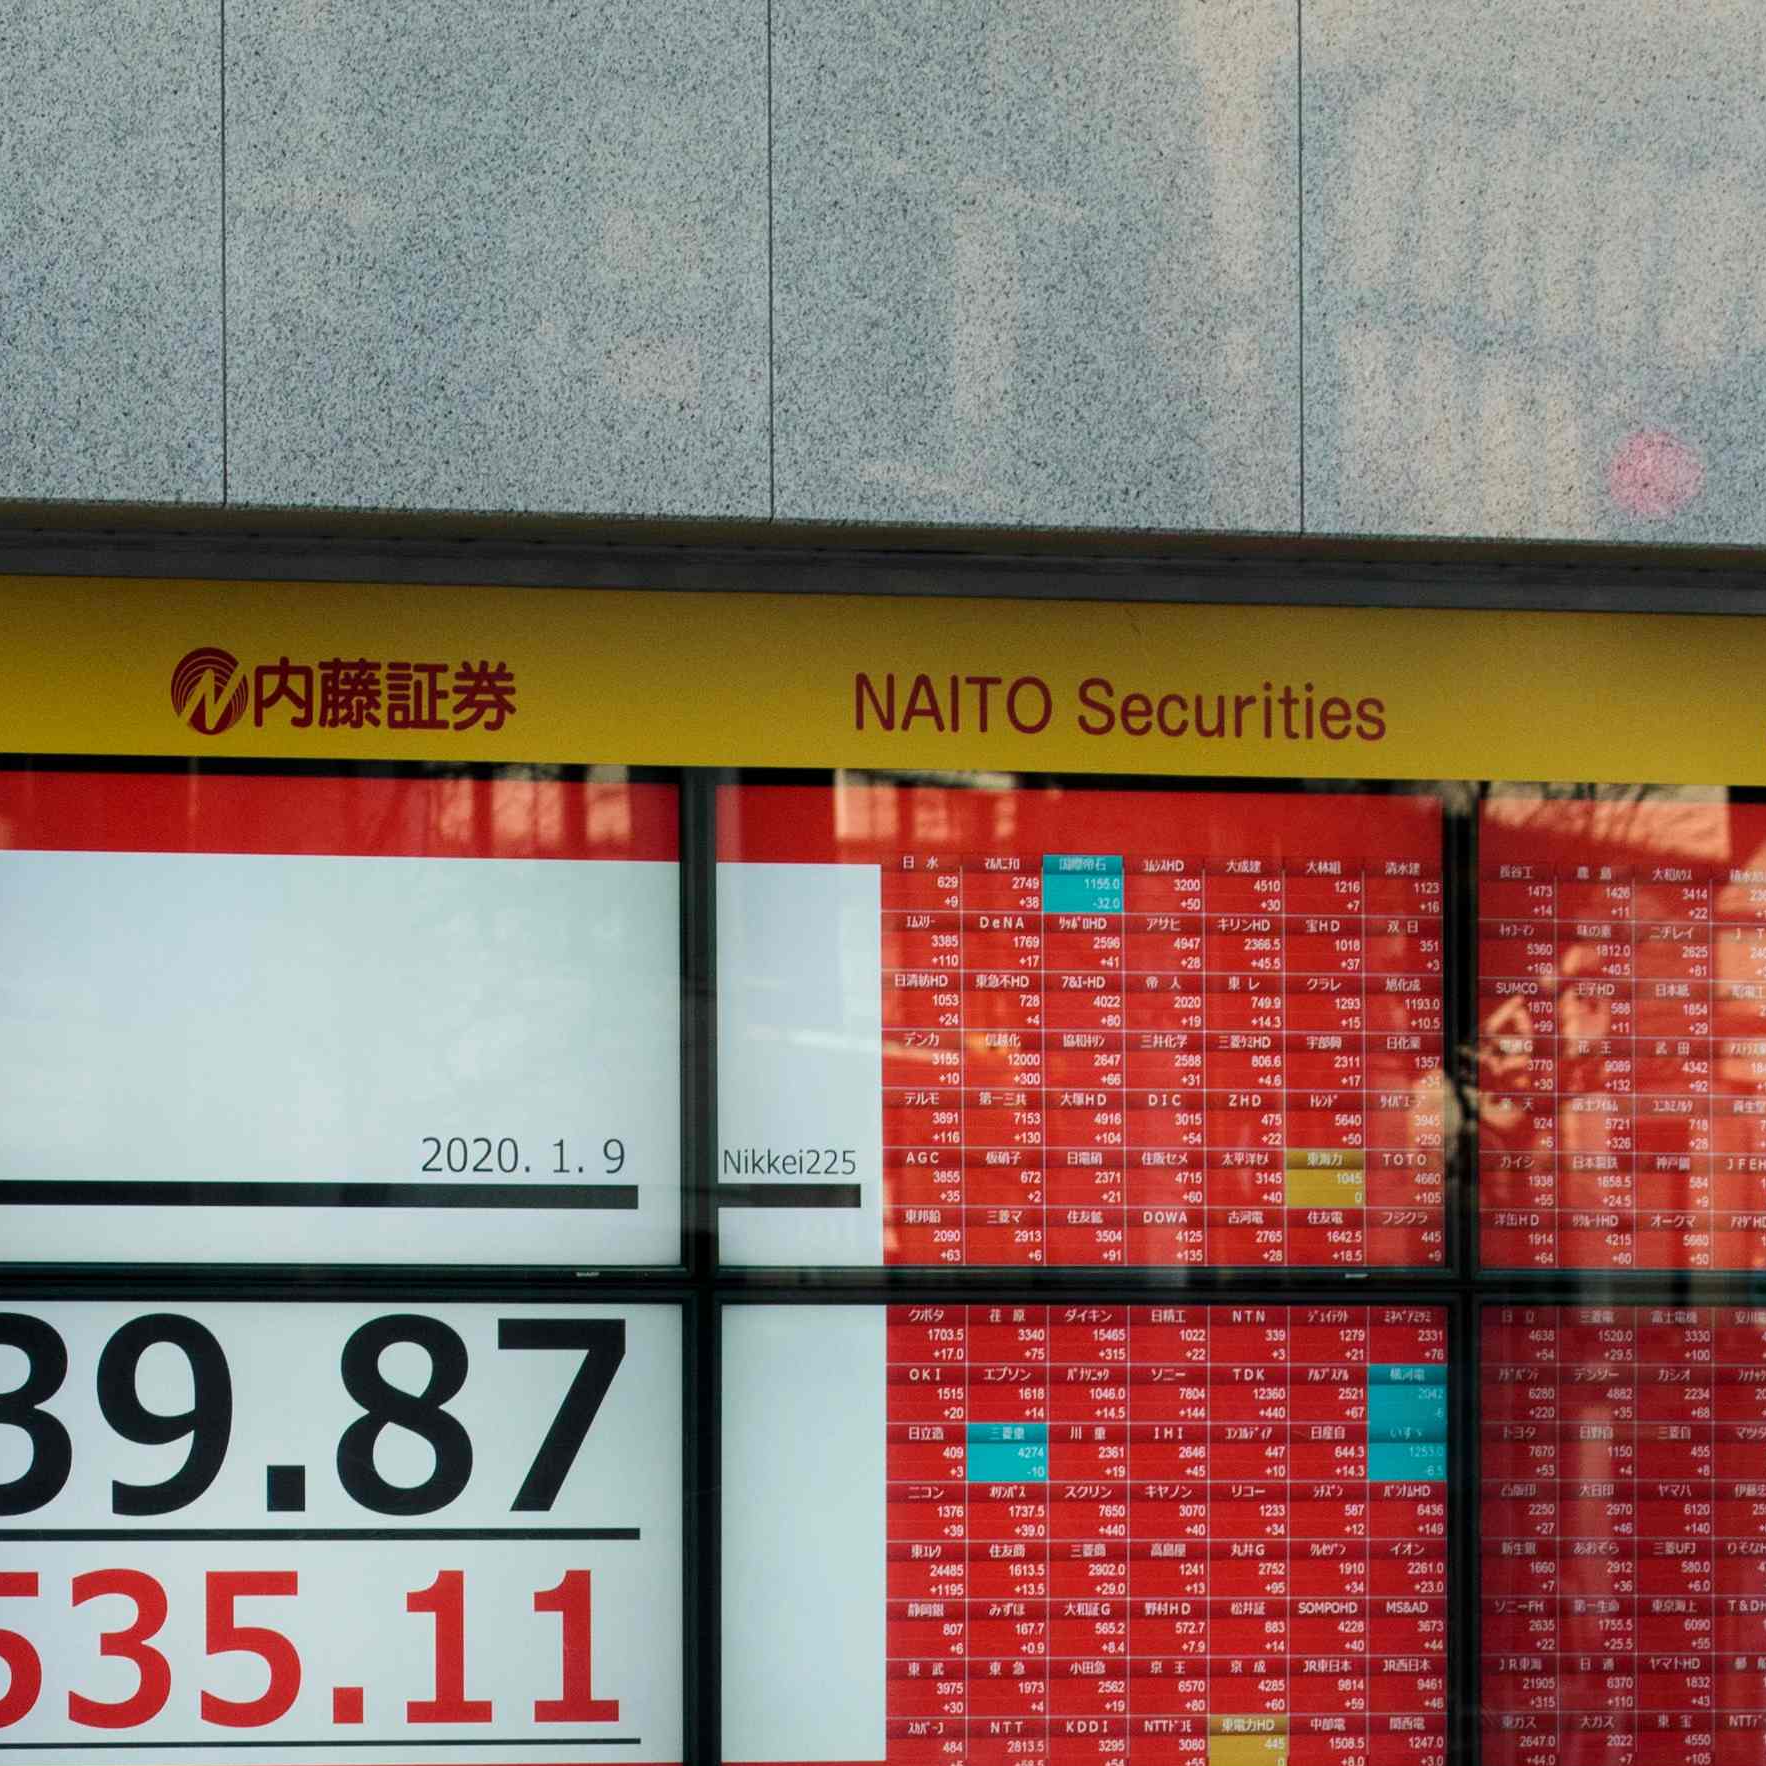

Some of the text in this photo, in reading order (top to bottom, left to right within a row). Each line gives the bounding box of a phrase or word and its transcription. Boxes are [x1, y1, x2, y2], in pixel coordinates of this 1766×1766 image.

[252, 657, 517, 734] 内藤証券
[854, 672, 1386, 742] NAITO Securities
[936, 875, 962, 889] 629
[1012, 876, 1040, 889] 2749
[1173, 878, 1201, 892] 3200
[1253, 879, 1284, 893] 4510
[1334, 880, 1361, 894] 1216
[1528, 885, 1554, 898] 1473
[944, 895, 962, 909] +9
[1180, 897, 1204, 911] +50
[1260, 898, 1284, 912] +30
[1346, 899, 1360, 911] +7
[1533, 905, 1553, 917] +14
[1146, 916, 1181, 931] アサヒ
[1013, 935, 1040, 949] 1769
[1018, 954, 1040, 967] +17
[1250, 957, 1282, 971] +45.5
[1306, 977, 1342, 992] クラレ
[1019, 994, 1040, 1008] 728
[1092, 995, 1121, 1009] 4022
[1334, 997, 1362, 1011] 1293
[1340, 1016, 1362, 1030] +15
[1012, 1072, 1041, 1085] +300
[905, 1091, 940, 1105] テルモ
[932, 1111, 959, 1125] 3891
[1013, 1111, 1042, 1125] 7153
[1174, 1112, 1202, 1126] 3015
[1260, 1113, 1283, 1127] 475
[1014, 1131, 1042, 1144] +130
[1182, 1131, 1202, 1145] +54
[1261, 1131, 1283, 1146] +22
[420, 1137, 532, 1176] 2020.
[602, 1137, 626, 1176] 9
[722, 1147, 858, 1177] Nikkei225
[1014, 1229, 1042, 1243] 2913
[1174, 1230, 1203, 1243] 4125
[1175, 1249, 1203, 1262] +135
[908, 1308, 944, 1322] クボタ
[1064, 1308, 1112, 1323] ダイキン
[928, 1327, 964, 1341] 1703.5
[1179, 1328, 1206, 1342] 1022
[1265, 1329, 1286, 1342] 339
[933, 1347, 964, 1361] +17.0
[1098, 1347, 1126, 1361] +315
[984, 1366, 1032, 1381] エプソン
[1151, 1367, 1186, 1381] ソニー
[937, 1387, 964, 1400] 1515
[1684, 1387, 1710, 1401] 2234
[943, 1406, 964, 1420] +20
[1024, 1407, 1045, 1419] +14
[1178, 1407, 1206, 1419] +144
[1258, 1406, 1286, 1419] +440
[1264, 1445, 1286, 1458] 447
[1184, 1465, 1206, 1478] +45
[908, 1486, 944, 1499] ニコン
[1064, 1485, 1112, 1499] スクリン
[1231, 1484, 1266, 1497] リコー
[1178, 1503, 1206, 1517] 3070
[1259, 1503, 1286, 1517] 1233
[1684, 1521, 1711, 1535] +140
[1390, 1542, 1425, 1555] イオン
[1179, 1562, 1204, 1576] 1241
[1258, 1561, 1286, 1576] 2752
[930, 1583, 964, 1597] +1195
[1414, 1580, 1444, 1594] +23.0
[990, 1603, 1025, 1616] みずほ
[1298, 1601, 1358, 1615] SOMPOHD
[936, 1681, 964, 1695] 3975
[1098, 1739, 1126, 1753] 3295
